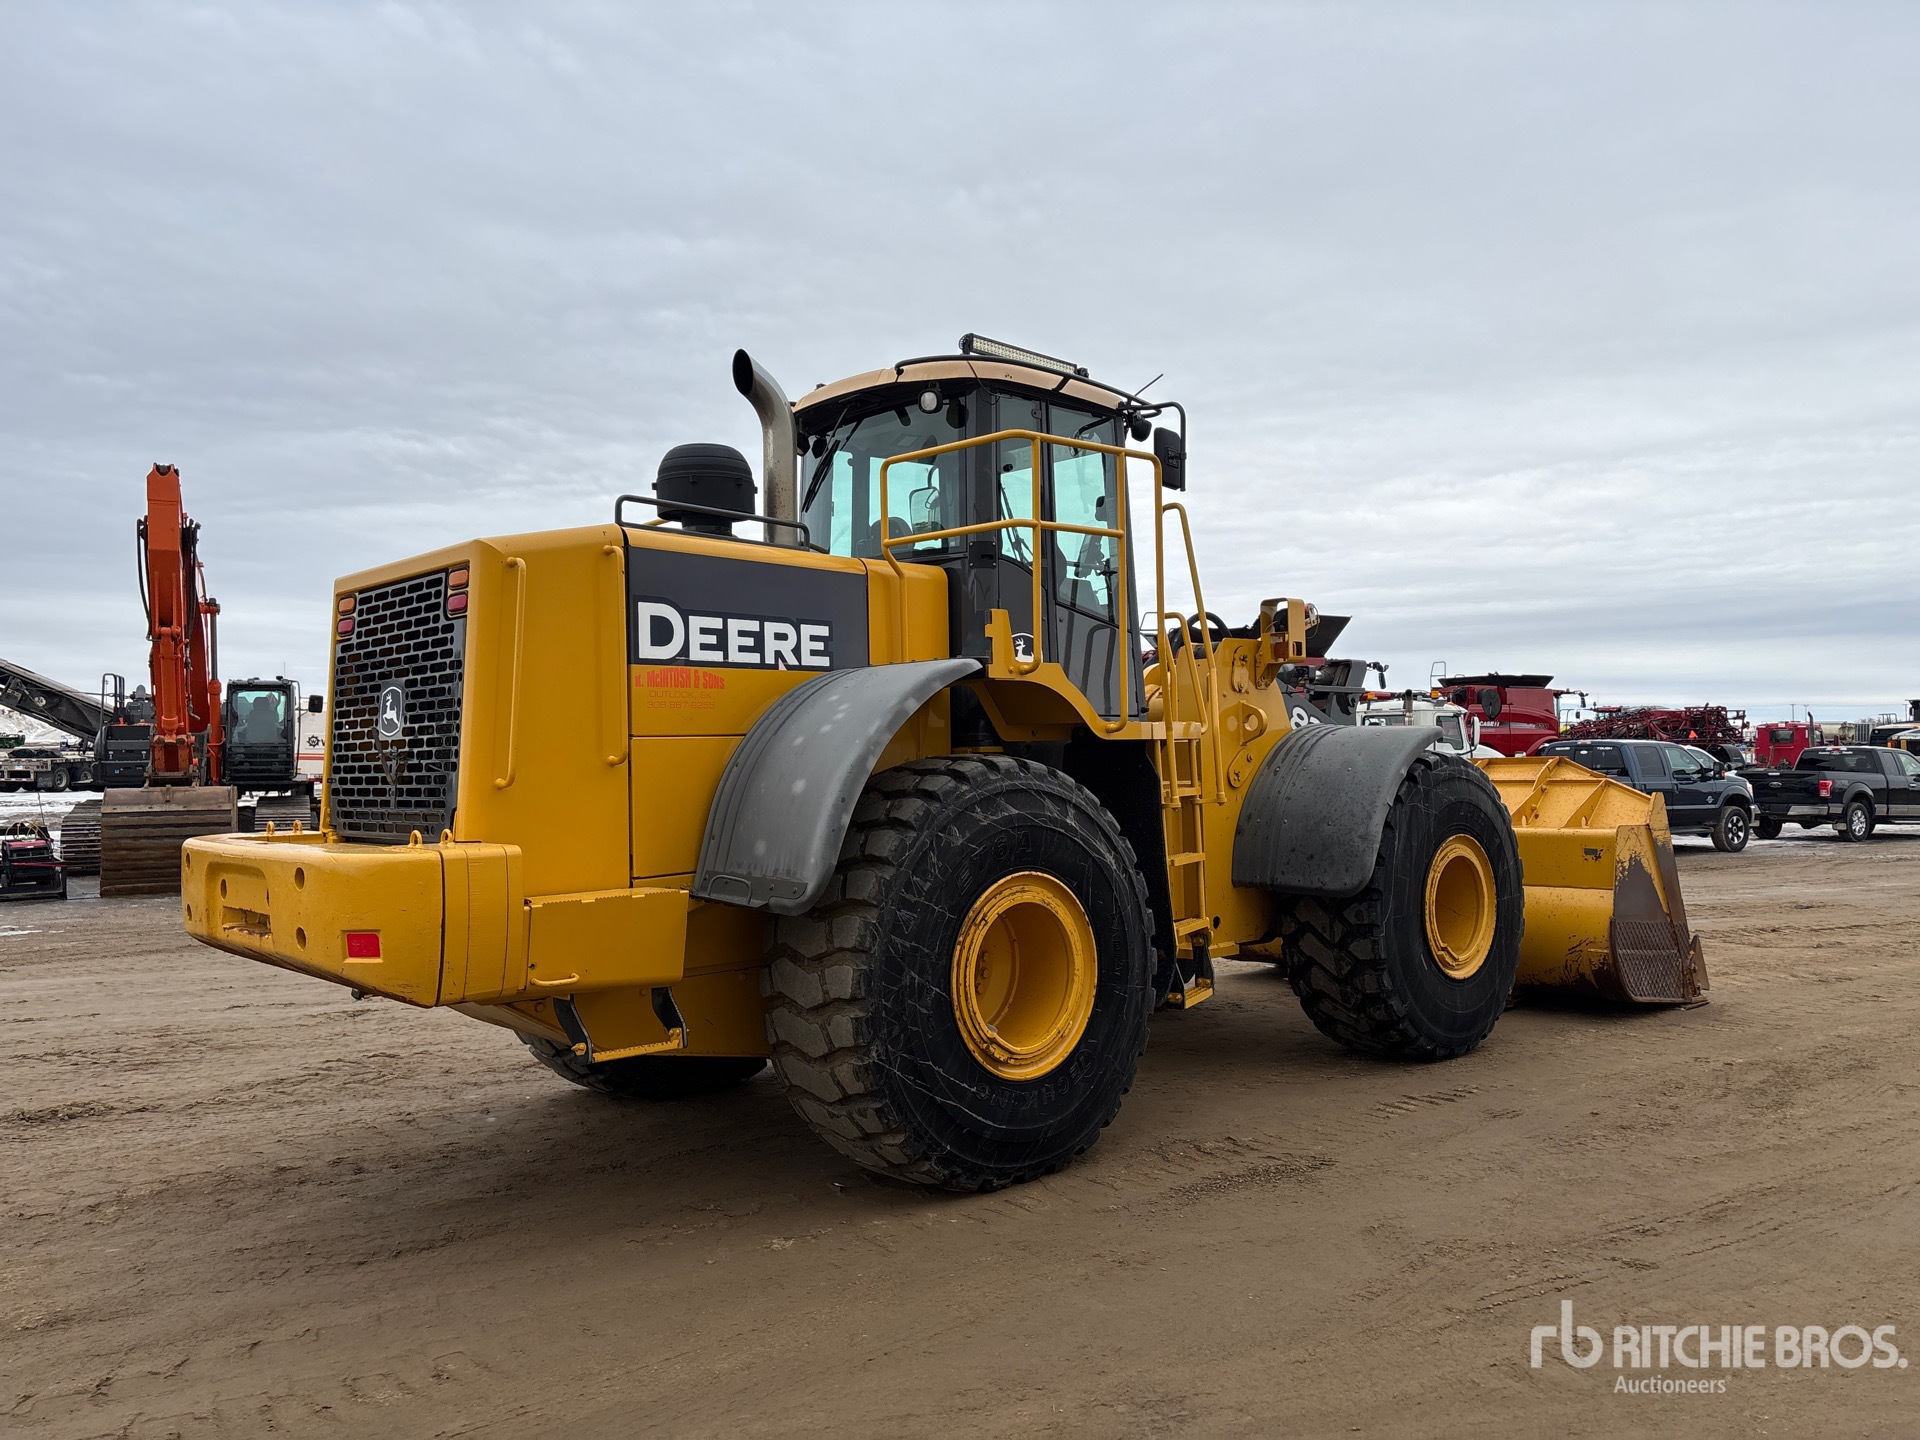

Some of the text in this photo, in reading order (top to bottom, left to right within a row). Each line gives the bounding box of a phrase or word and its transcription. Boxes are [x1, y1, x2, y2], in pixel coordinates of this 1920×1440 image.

[637, 601, 831, 667] DEERE
[693, 669, 700, 688] &
[702, 671, 726, 690] SONS
